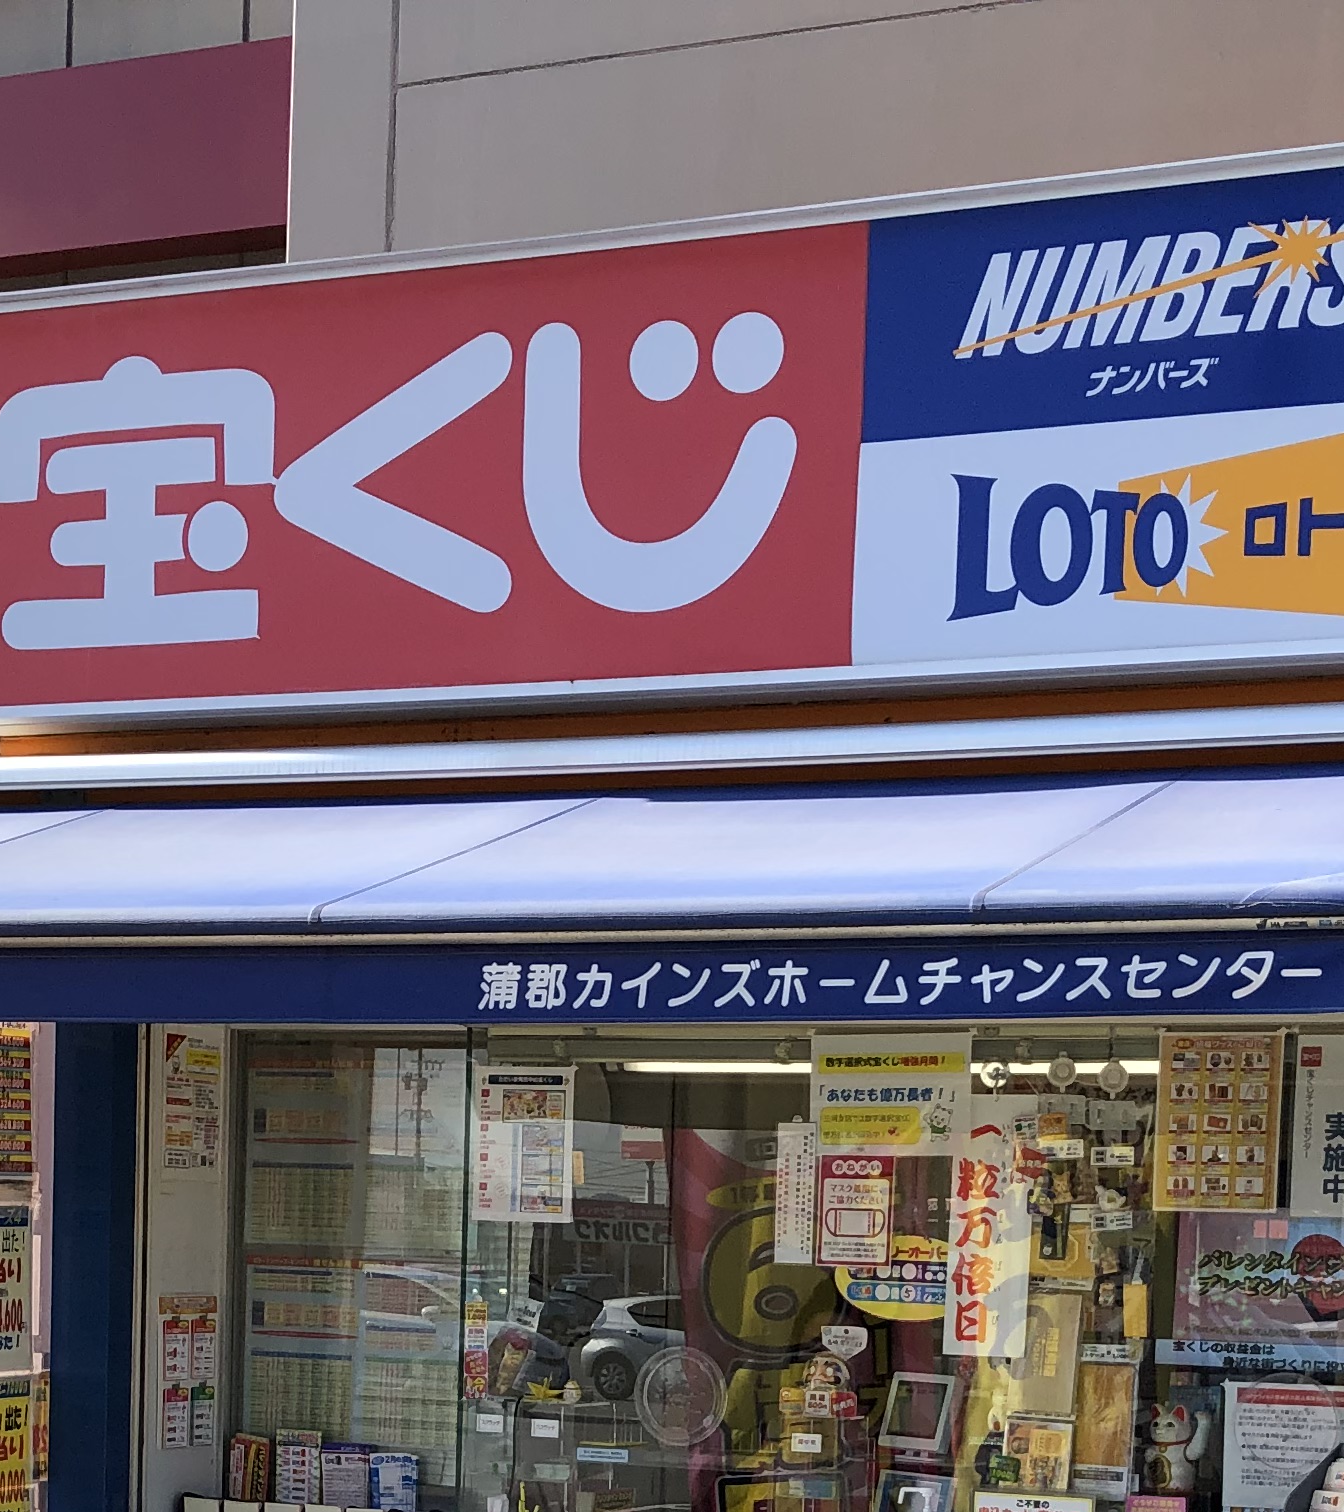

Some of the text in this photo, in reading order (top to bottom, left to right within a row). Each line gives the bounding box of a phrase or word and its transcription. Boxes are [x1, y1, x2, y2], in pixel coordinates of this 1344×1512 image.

[1086, 358, 1219, 397] ナンバーズ
[946, 473, 1190, 622] LOTO
[479, 949, 1324, 1010] 蒲郡カインズホームチャンスセンター
[1172, 1339, 1276, 1357] 宝くじの収益金は
